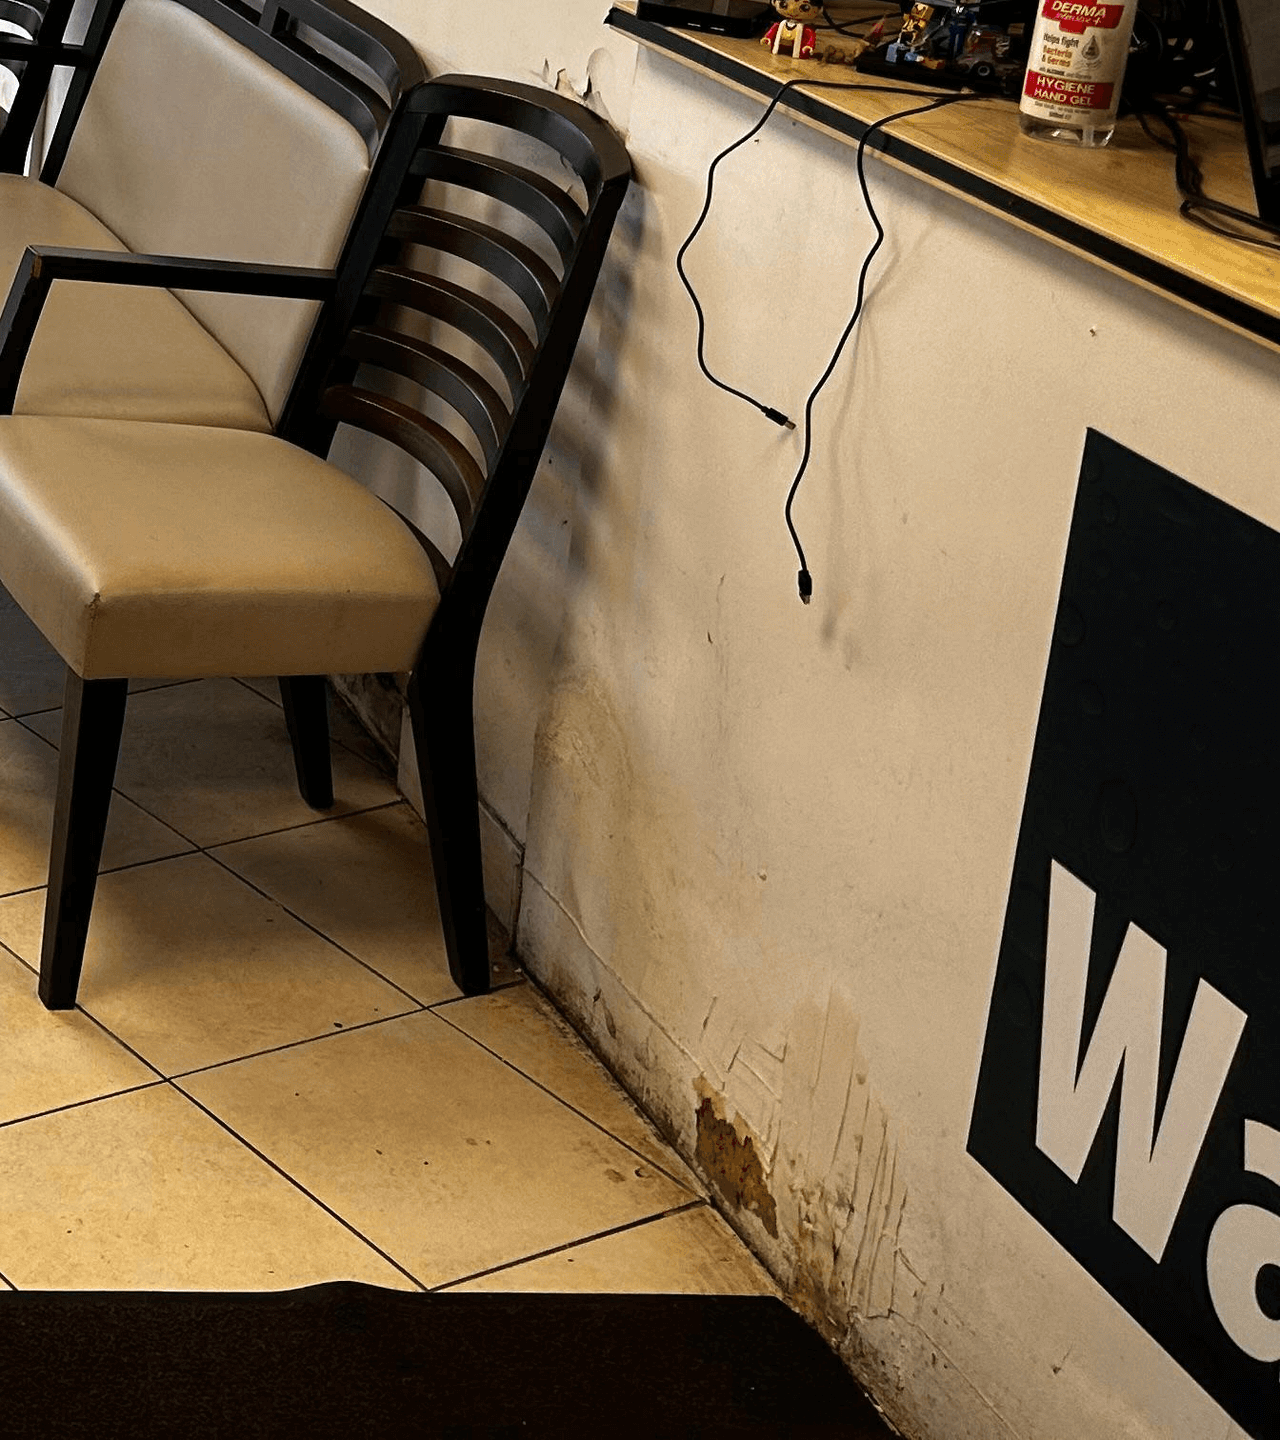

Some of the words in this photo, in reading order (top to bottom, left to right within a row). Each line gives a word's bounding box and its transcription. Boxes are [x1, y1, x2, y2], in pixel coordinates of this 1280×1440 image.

[1052, 0, 1107, 19] DERMA
[1043, 33, 1061, 46] Helps
[1061, 35, 1080, 49] fight
[1042, 45, 1073, 59] Bacteria
[1047, 55, 1071, 68] Germs
[1036, 75, 1096, 94] HYGIENE
[1033, 88, 1067, 103] HAND
[1070, 95, 1093, 106] GEL
